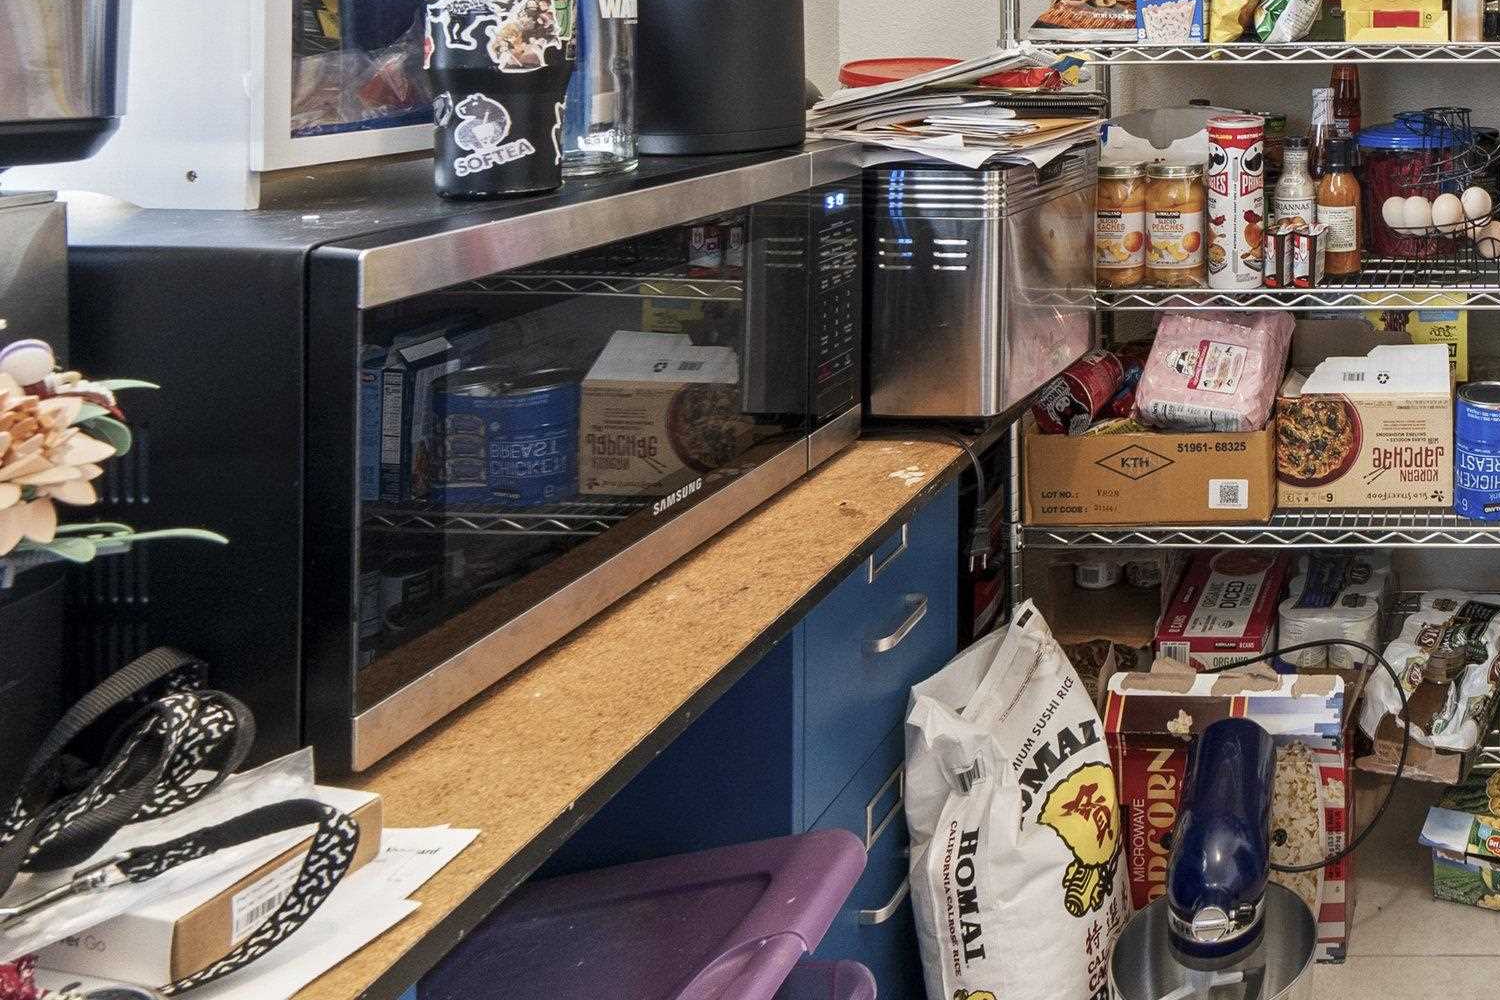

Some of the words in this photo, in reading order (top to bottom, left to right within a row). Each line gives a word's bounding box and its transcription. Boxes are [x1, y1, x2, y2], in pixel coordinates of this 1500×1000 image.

[1120, 456, 1150, 468] KTH
[1177, 443, 1212, 454] 51961-
[1215, 442, 1247, 452] 68325
[652, 477, 703, 516] SAMSUNG
[1041, 505, 1059, 514] LOT
[1219, 581, 1246, 609] DICED
[1032, 700, 1060, 737] SUSHI
[1057, 676, 1075, 700] RICE
[1018, 718, 1101, 815] OMAI
[1132, 798, 1145, 882] MICROWAVE
[1146, 748, 1177, 905] OPCORN
[942, 820, 958, 894] CALIFORNIA
[952, 949, 962, 977] RICE
[954, 826, 987, 965] HOMAI
